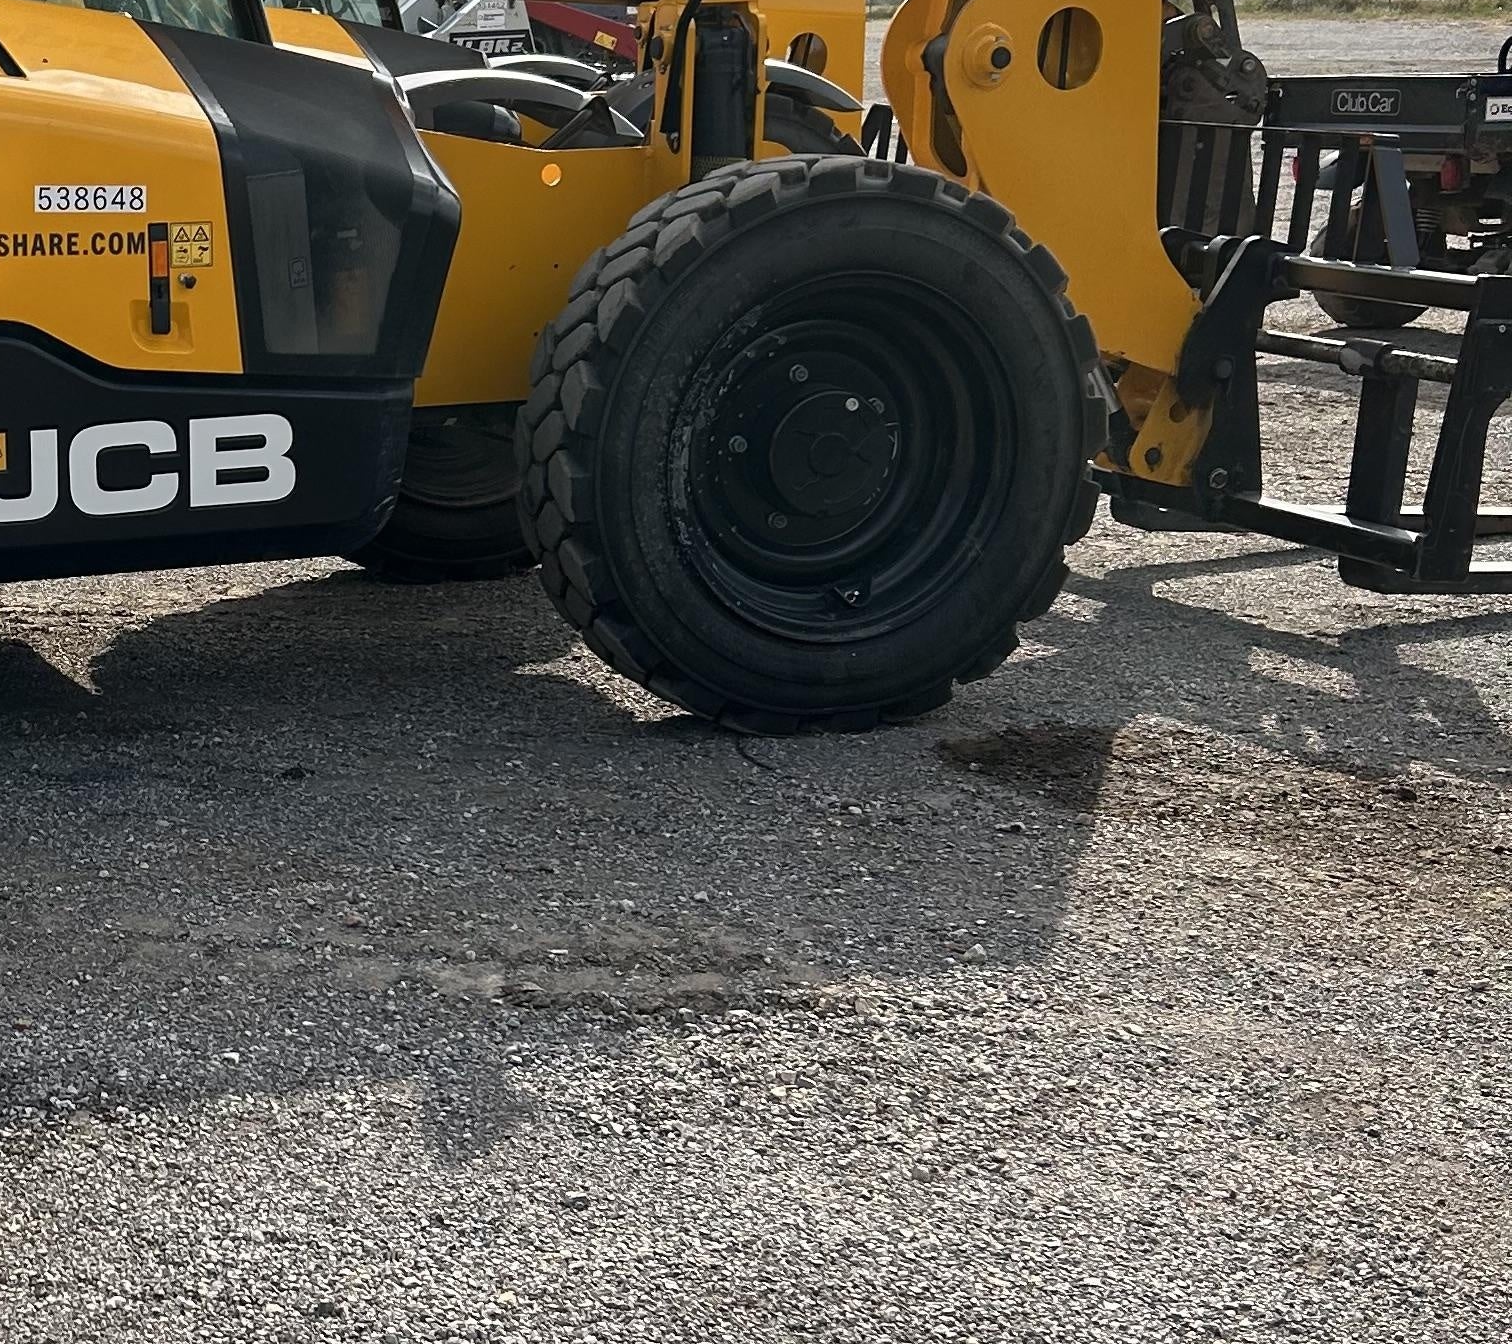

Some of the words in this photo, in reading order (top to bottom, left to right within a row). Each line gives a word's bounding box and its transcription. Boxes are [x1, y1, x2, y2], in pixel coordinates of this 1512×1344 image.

[1337, 92, 1366, 112] Club
[1368, 92, 1395, 113] Car
[37, 186, 145, 211] 538648
